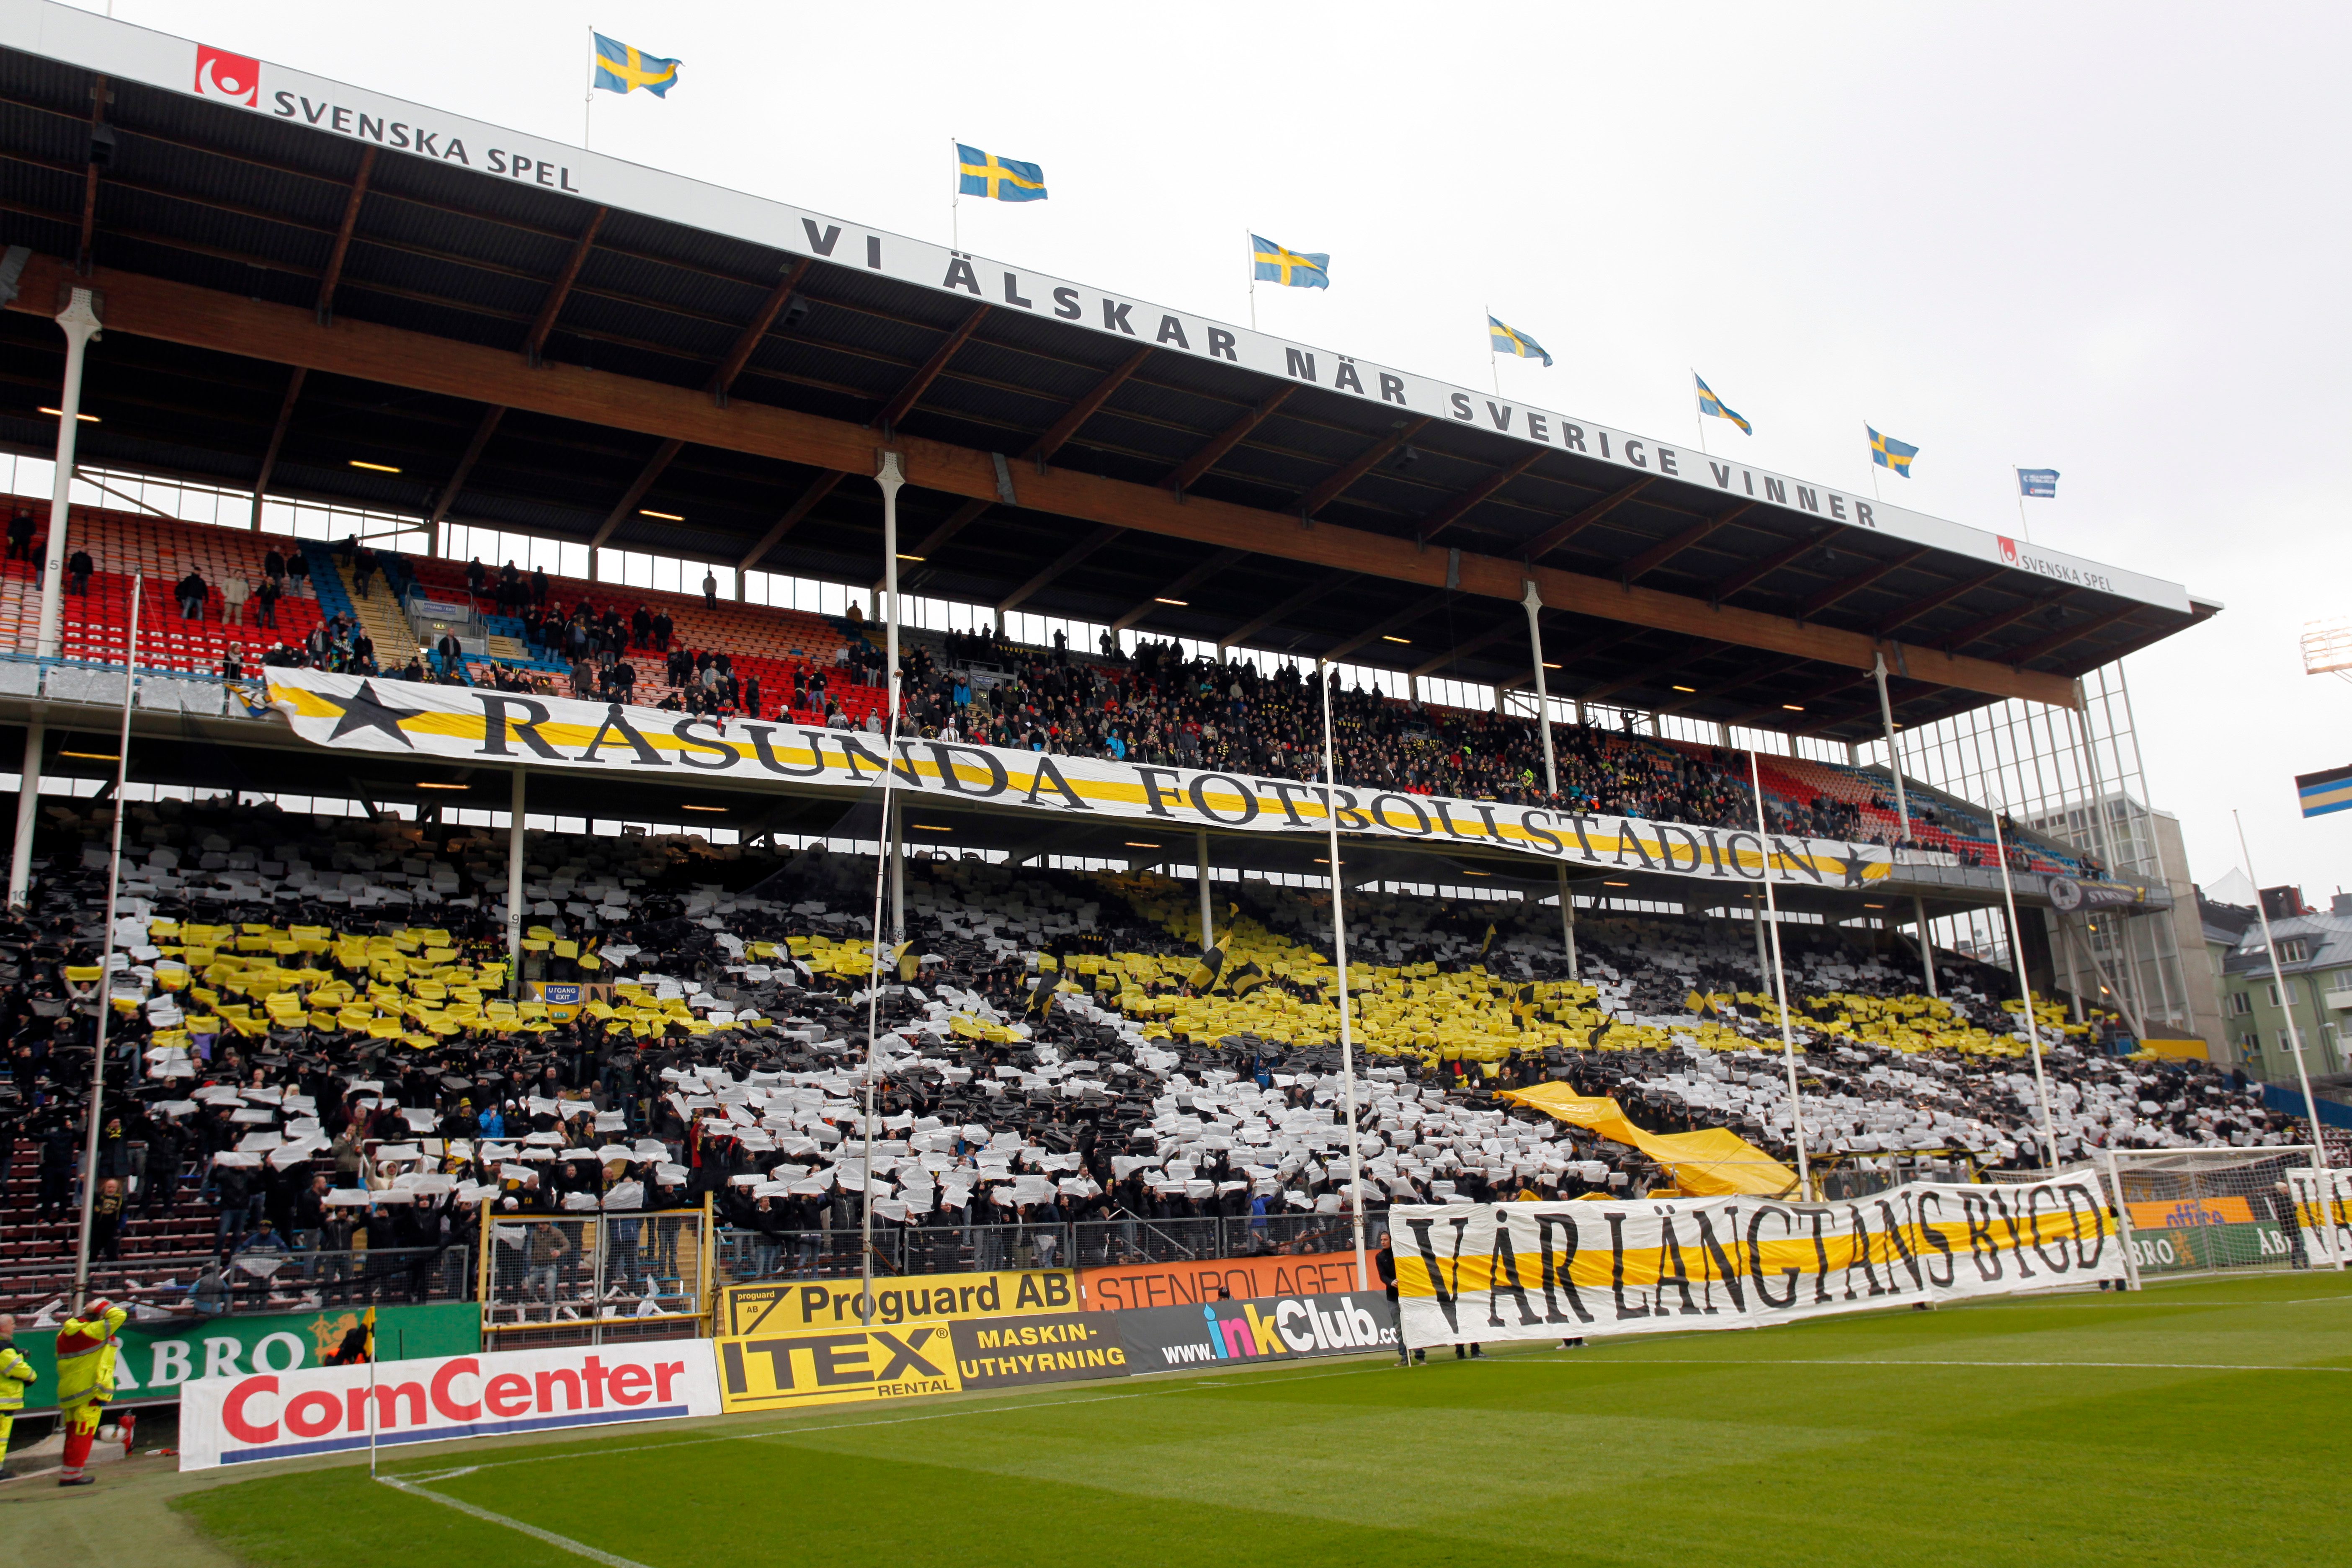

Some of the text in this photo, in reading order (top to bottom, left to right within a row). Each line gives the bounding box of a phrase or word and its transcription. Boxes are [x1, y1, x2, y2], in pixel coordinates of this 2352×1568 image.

[274, 91, 579, 193] SVENSKA SPEL
[801, 217, 1876, 528] VI ÄLSKAR NÄR SVERIGE VINNER
[50, 560, 59, 570] 5
[2022, 555, 2114, 592] SVENSKA SPEL
[472, 693, 1823, 884] RÅSUNDA FOTBOLLSTADION
[512, 914, 519, 923] 9
[897, 931, 903, 939] 8
[1406, 1182, 2104, 1334] VÅR LÄNGTANS BYGD
[737, 1290, 775, 1301] proguard
[801, 1273, 1071, 1325] Proguard AB
[977, 1323, 1097, 1349] MASKIN-
[723, 1328, 945, 1394] ITEX
[960, 1347, 1126, 1379] UTHYRNING
[222, 1355, 685, 1443] ComCenter
[878, 1379, 955, 1397] RENTAL
